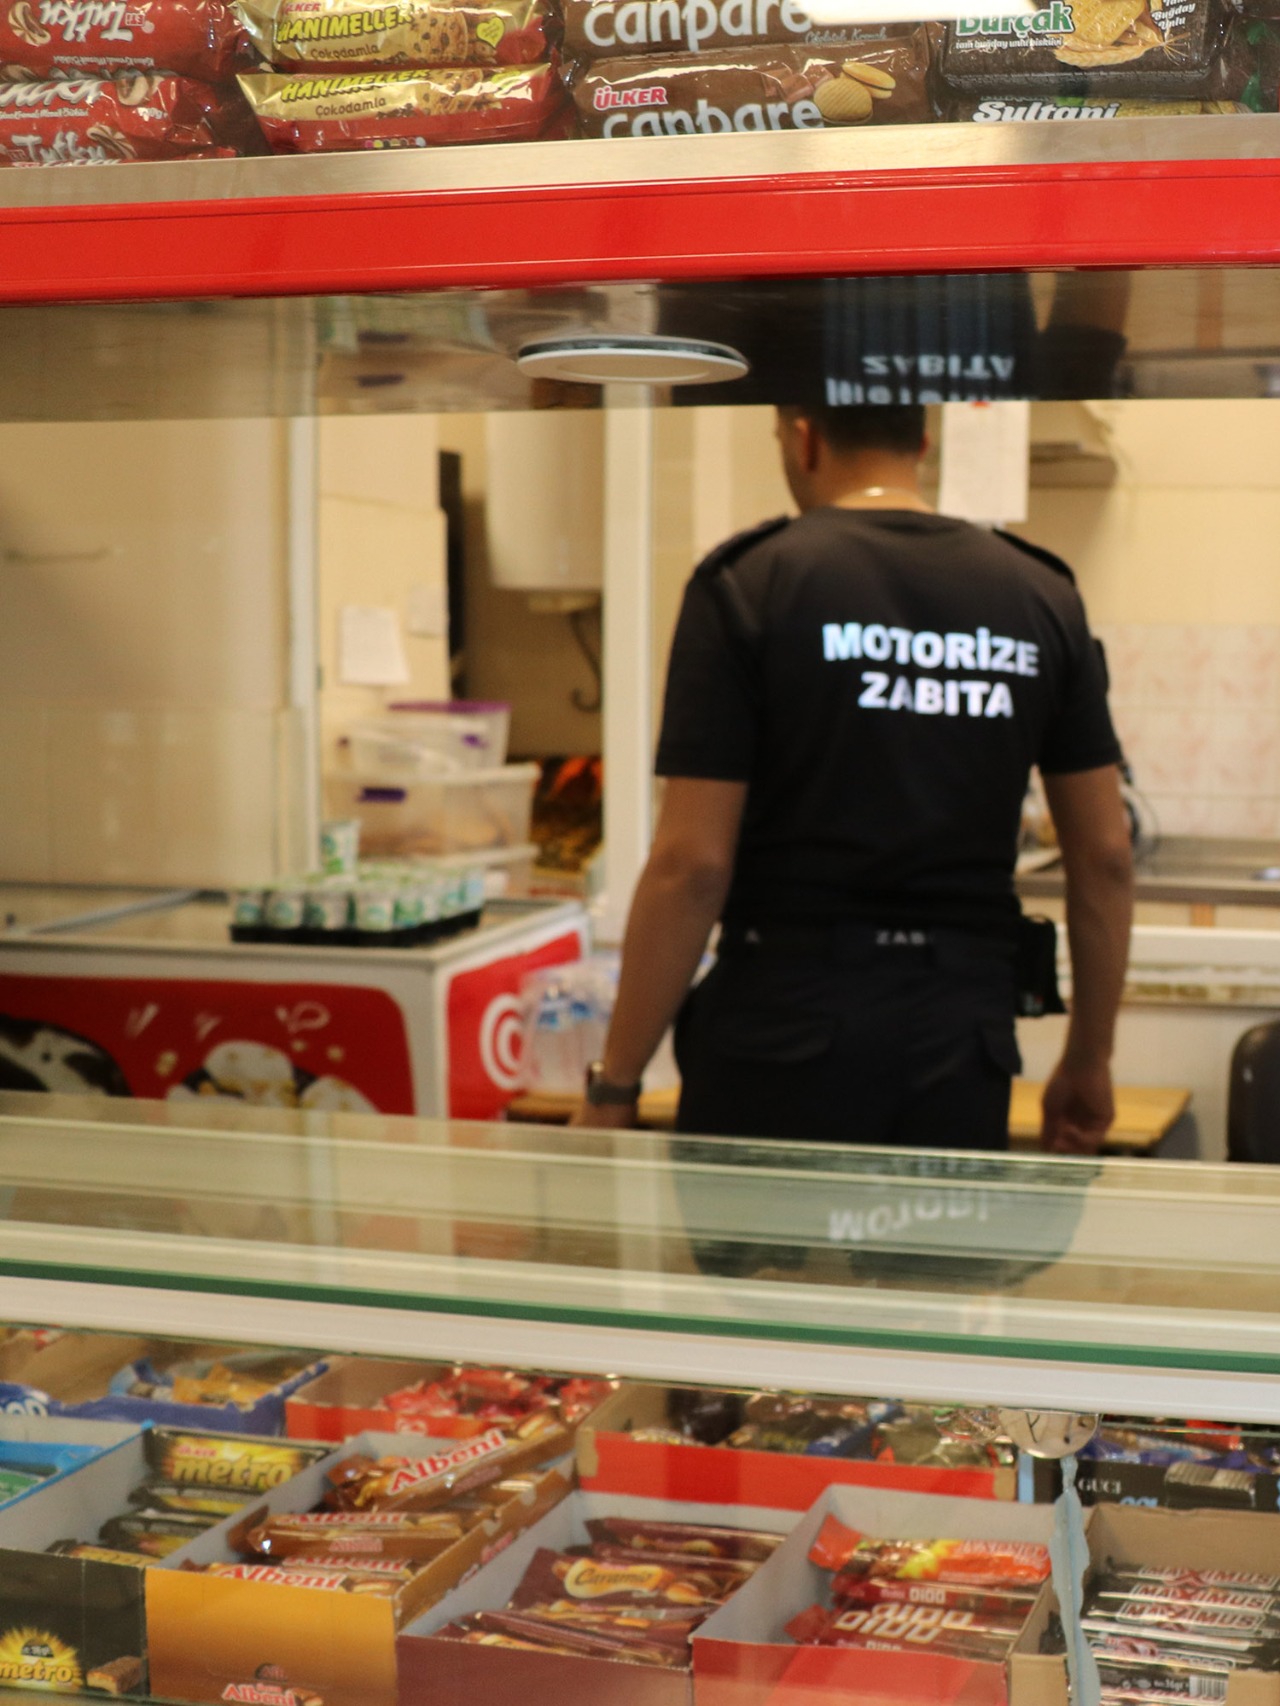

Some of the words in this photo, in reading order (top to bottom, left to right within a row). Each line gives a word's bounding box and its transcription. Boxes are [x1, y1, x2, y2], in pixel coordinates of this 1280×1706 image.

[583, 0, 812, 52] canpare
[956, 1, 1076, 39] Burçak
[594, 86, 668, 110] ÜLKER
[822, 622, 1040, 677] MOTORİZE
[857, 671, 1014, 719] ZABITA
[173, 1455, 291, 1490] metro
[387, 1427, 507, 1496] Albeni
[0, 1660, 72, 1682] metro
